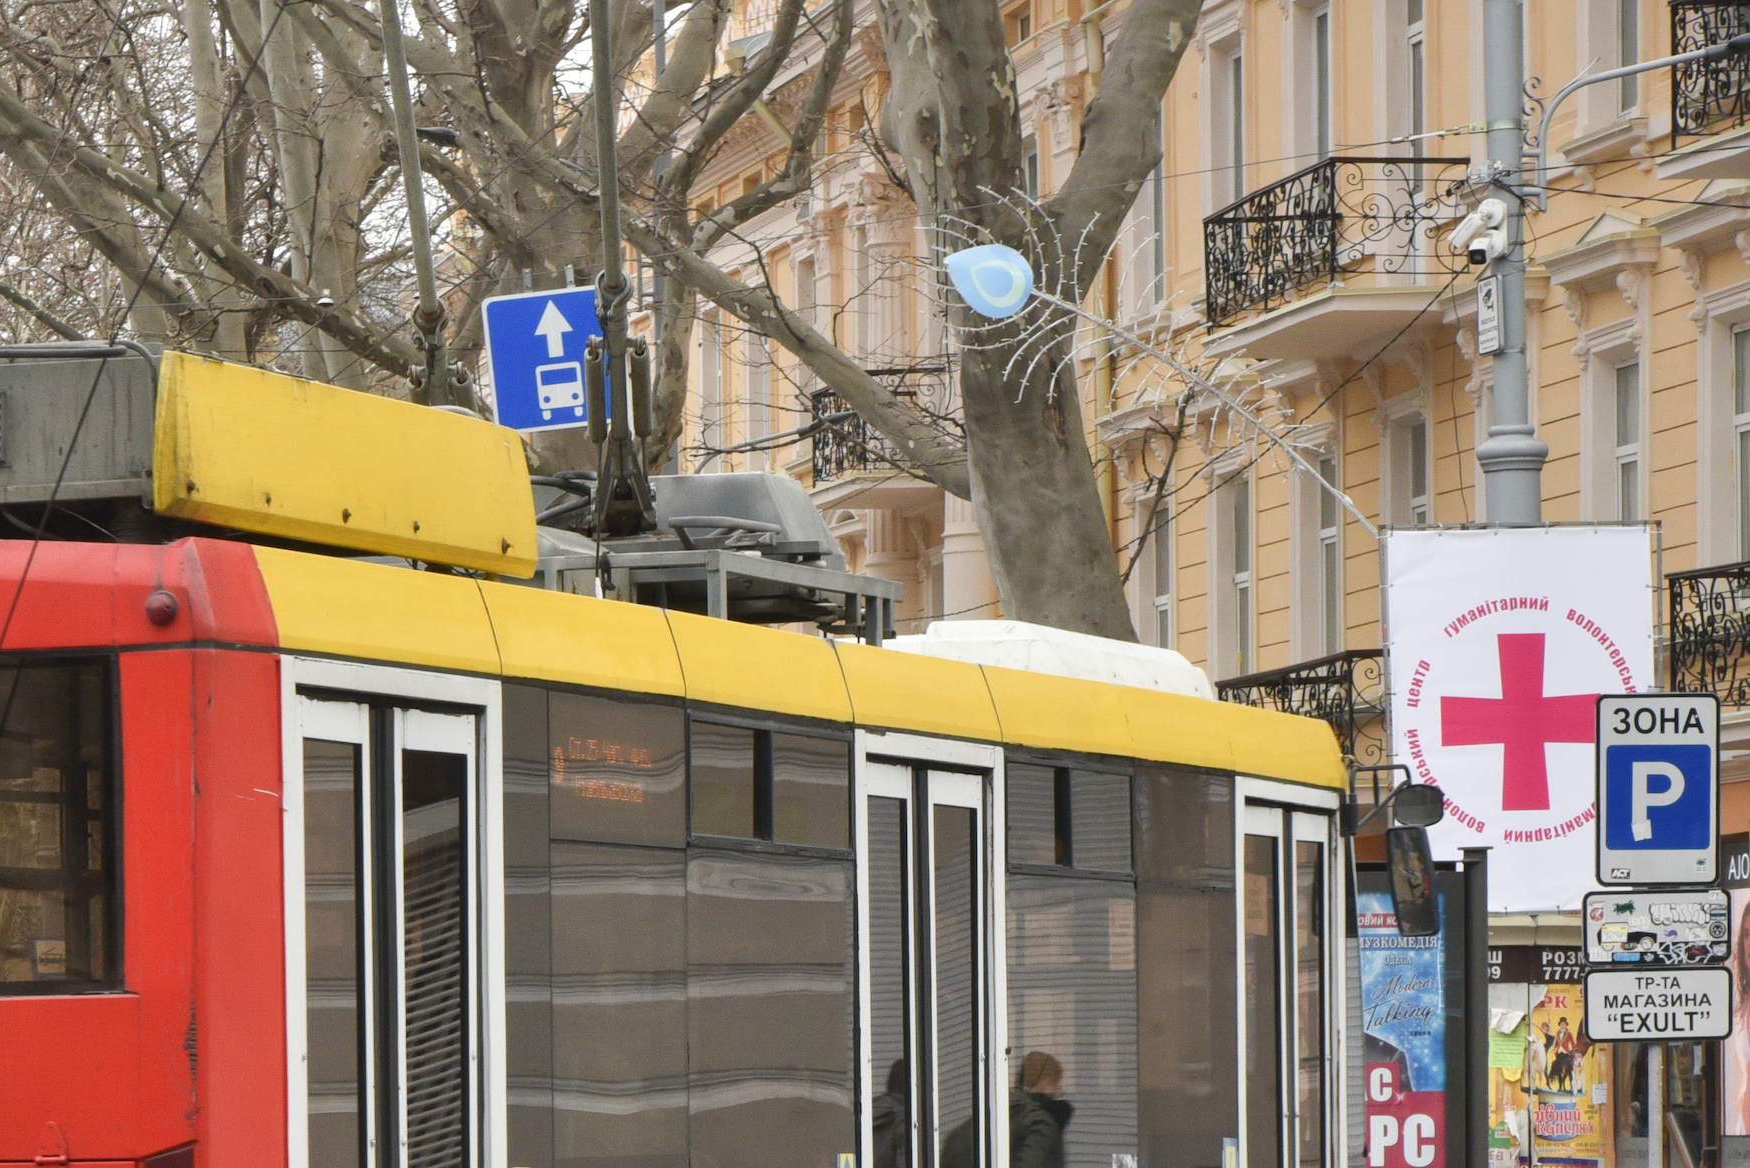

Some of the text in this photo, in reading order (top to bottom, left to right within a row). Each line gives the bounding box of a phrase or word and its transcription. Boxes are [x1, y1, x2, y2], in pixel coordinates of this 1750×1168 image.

[1443, 596, 1549, 638] гуманітарний
[1406, 659, 1431, 708] центр
[1612, 707, 1704, 734] ЗОНА
[1384, 956, 1412, 964] ОДЕСА
[1372, 975, 1431, 1000] Modern
[1635, 977, 1681, 990] ТР-ТА
[1604, 993, 1712, 1008] МАГАЗИНА
[1362, 998, 1432, 1031] Talking
